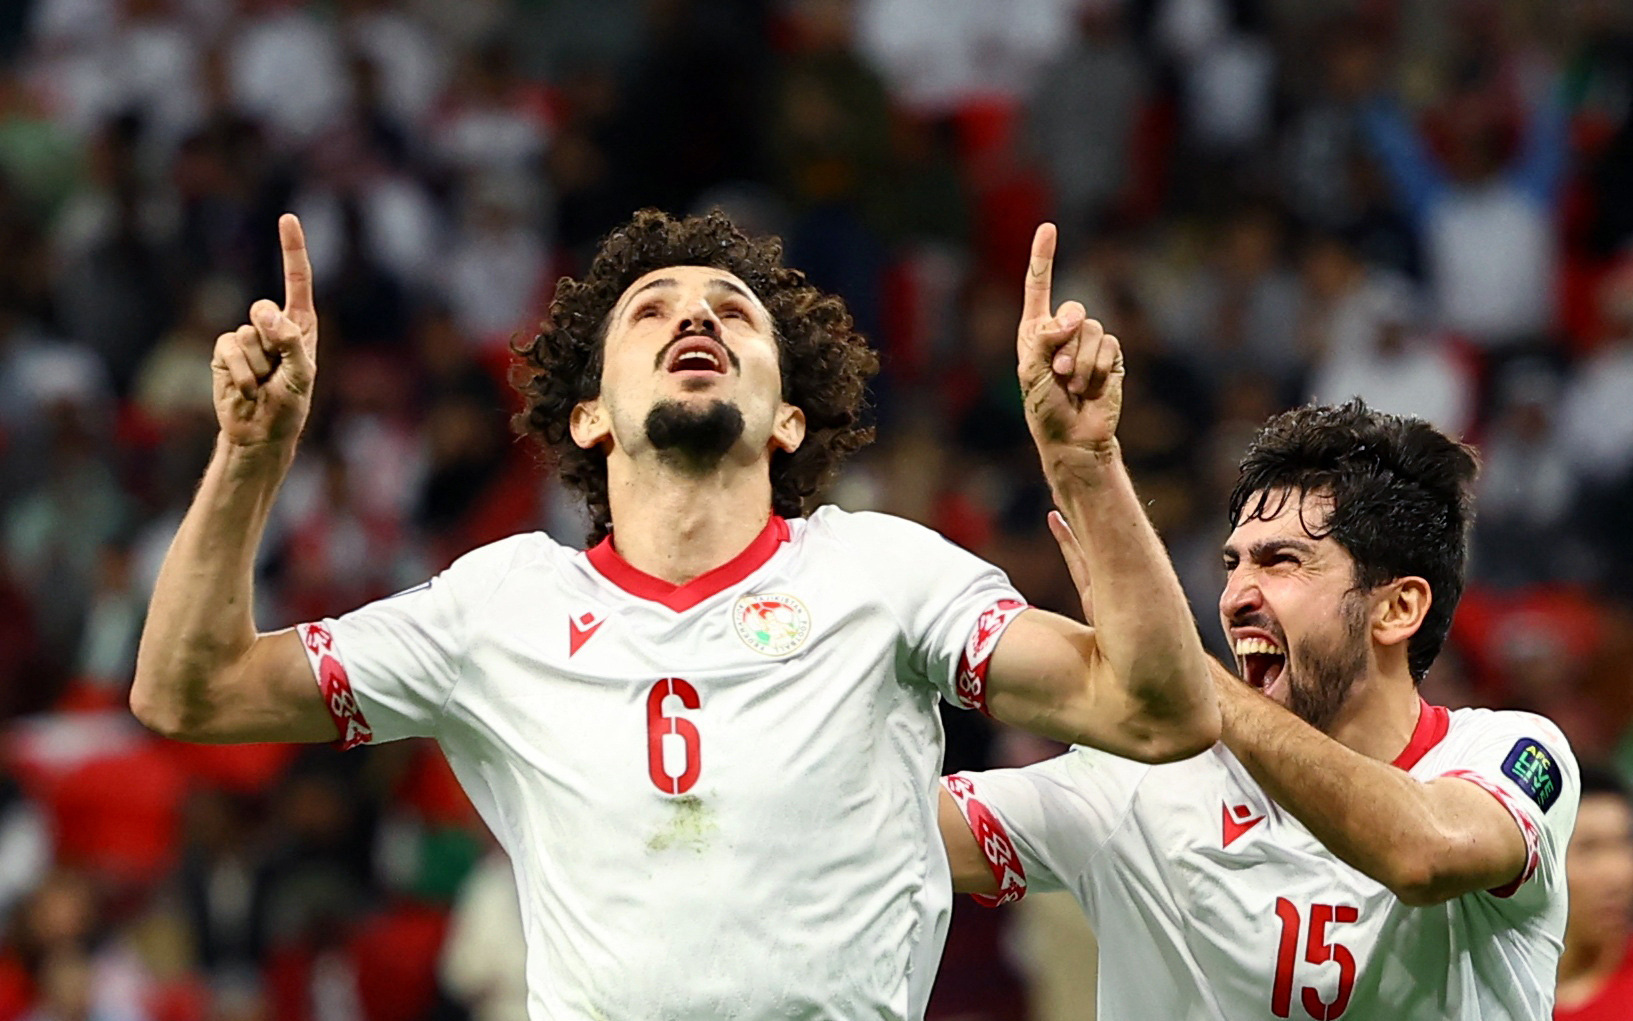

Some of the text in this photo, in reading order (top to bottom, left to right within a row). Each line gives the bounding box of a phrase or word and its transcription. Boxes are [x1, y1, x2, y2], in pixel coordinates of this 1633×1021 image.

[646, 677, 701, 795] 6
[1525, 745, 1551, 771] AFC
[1271, 896, 1358, 1021] 15
